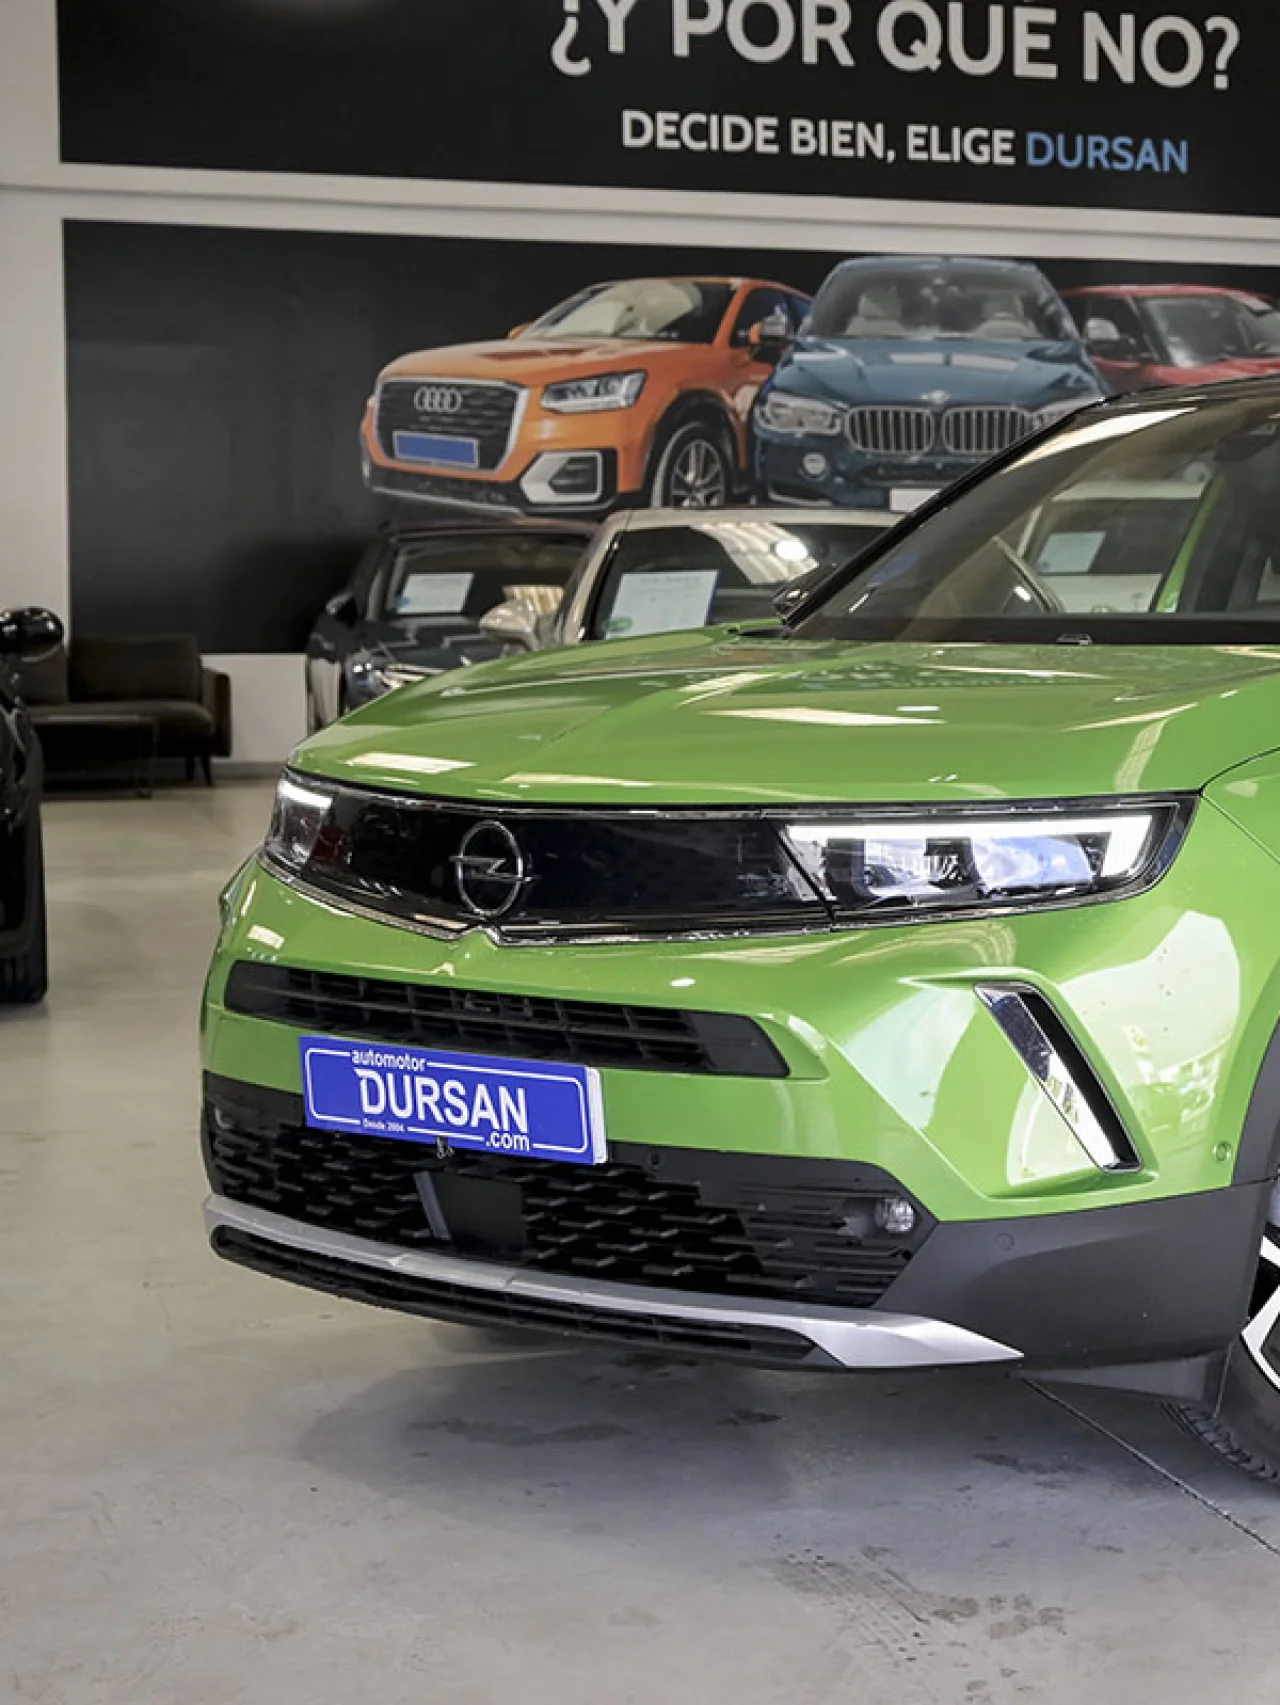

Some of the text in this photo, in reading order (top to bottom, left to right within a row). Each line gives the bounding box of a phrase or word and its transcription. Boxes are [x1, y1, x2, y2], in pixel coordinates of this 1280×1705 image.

[551, 0, 636, 76] ¿Y
[671, 0, 856, 66] POR
[1083, 11, 1241, 90] NO?
[622, 110, 1189, 174] DECIDE BIEN, ELIGE DURSAN
[352, 1049, 427, 1072] automotor
[354, 1068, 529, 1134] DURSAN
[485, 1130, 530, 1152] .com
